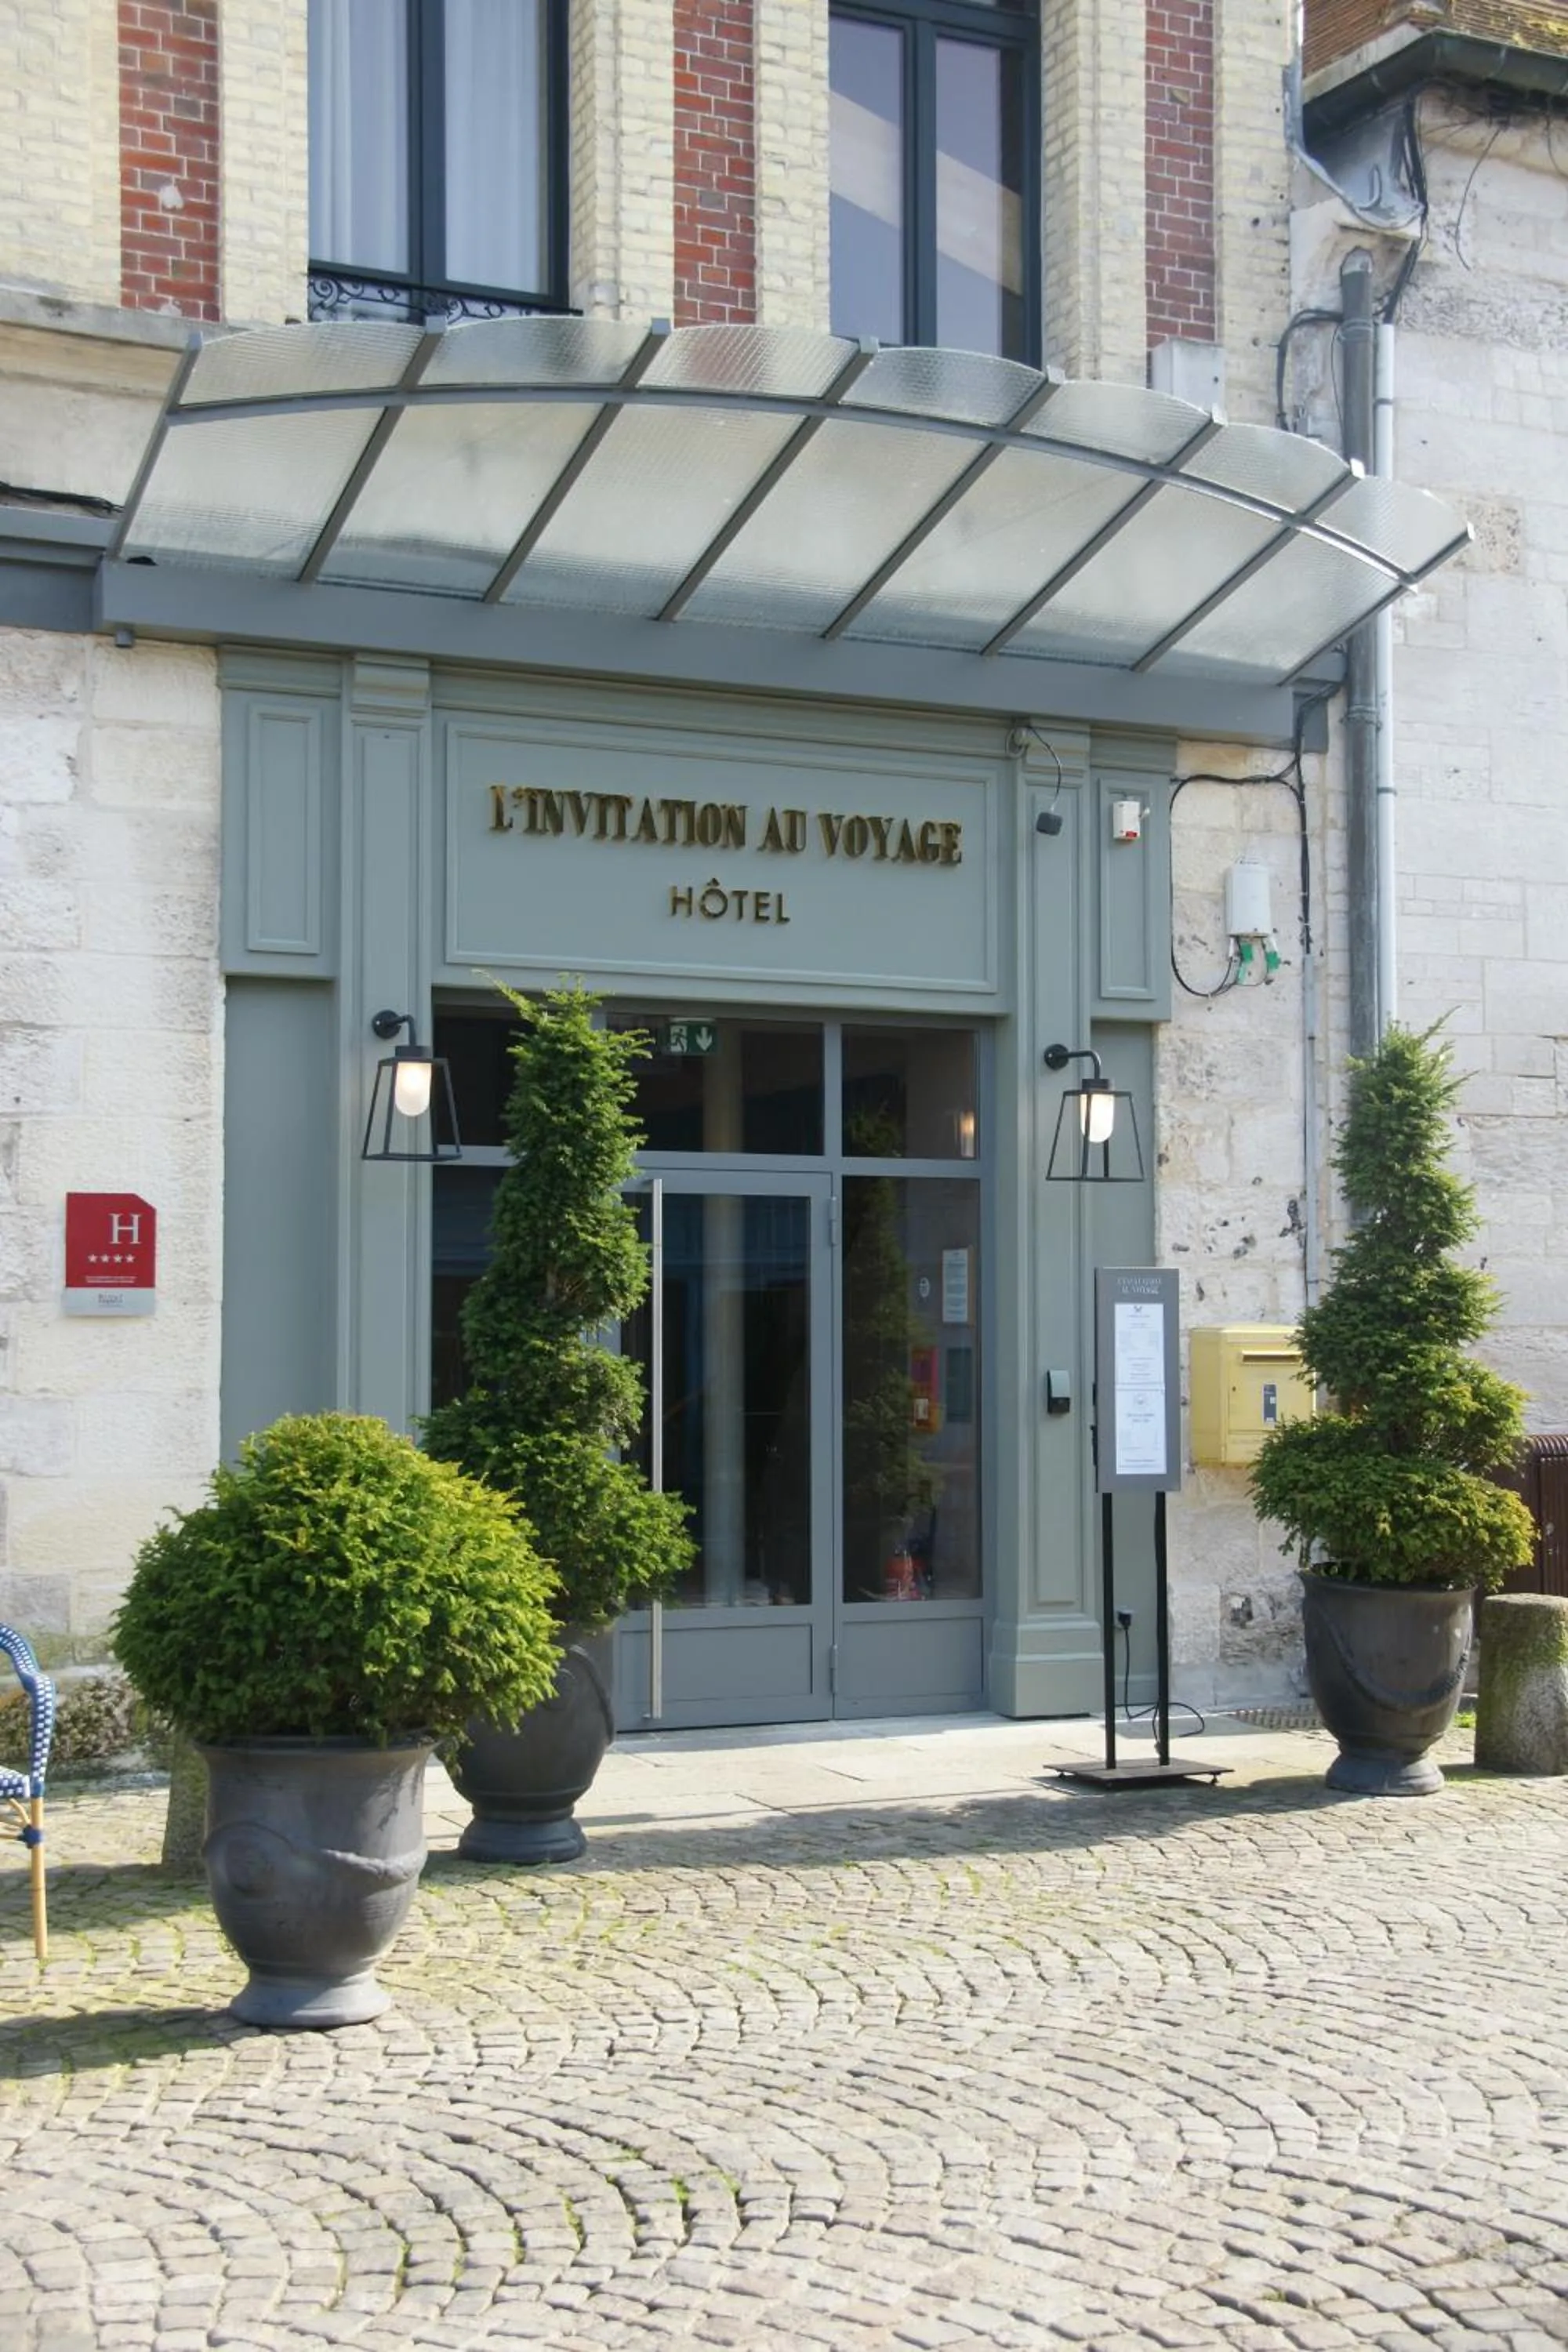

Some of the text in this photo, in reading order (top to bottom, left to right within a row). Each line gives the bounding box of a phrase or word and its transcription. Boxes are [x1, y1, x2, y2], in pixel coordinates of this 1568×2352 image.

[490, 785, 962, 866] L'INVITATION AU VOYAGE
[670, 878, 790, 924] HÔTEL
[108, 1212, 142, 1245] H
